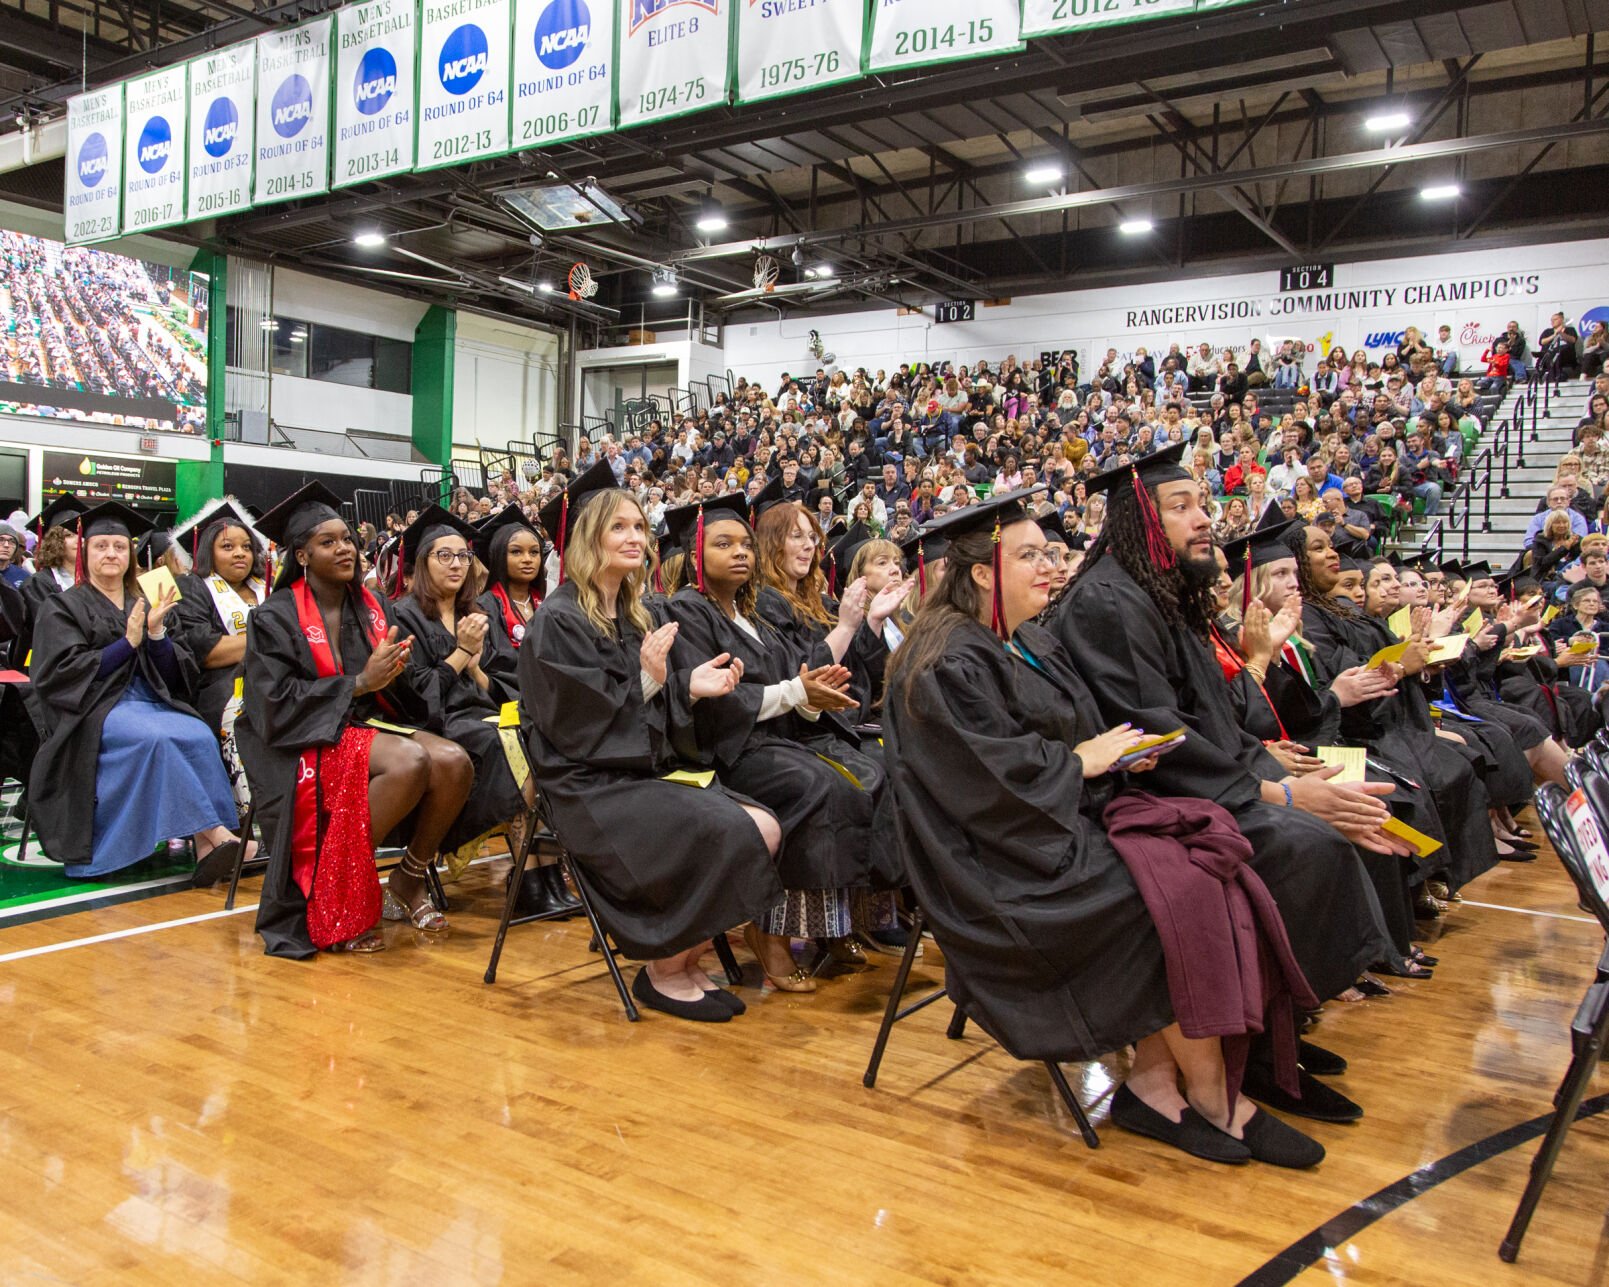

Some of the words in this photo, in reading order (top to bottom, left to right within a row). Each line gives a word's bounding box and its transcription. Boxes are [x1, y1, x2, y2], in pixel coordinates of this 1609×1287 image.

[357, 0, 392, 26] MEN'S
[342, 13, 412, 50] BASKETBALL
[540, 25, 591, 56] NCAA
[648, 21, 685, 48] ELITE
[689, 17, 699, 34] 8
[895, 18, 994, 56] 2014-15
[262, 43, 328, 73] BASKETBALL
[443, 52, 488, 83] NCAA
[760, 51, 840, 89] 1975-76
[144, 75, 169, 94] MEN'S
[195, 70, 251, 97] BASKETBALL
[356, 75, 397, 102] NCAA
[518, 76, 563, 98] ROUND
[568, 70, 585, 87] OF
[588, 63, 607, 81] 64
[83, 95, 107, 113] MEN'S
[129, 89, 183, 114] BASKETBALL
[424, 100, 465, 123] ROUND
[468, 95, 483, 112] OF
[487, 89, 504, 107] 64
[639, 77, 706, 114] 1974-75
[71, 105, 119, 130] BASKETBALL
[274, 101, 312, 126] NCAA
[340, 118, 375, 142] ROUND
[378, 114, 392, 131] OF
[395, 110, 410, 126] 64
[522, 105, 600, 140] 2006-07
[204, 121, 237, 146] NCAA
[433, 130, 492, 160] 2012-13
[141, 141, 171, 162] NCAA
[260, 144, 293, 161] ROUND
[295, 139, 308, 153] OF
[311, 135, 324, 149] 64
[80, 157, 108, 176] NCAA
[193, 163, 222, 179] ROUND
[224, 157, 235, 171] OF
[235, 153, 249, 167] 32
[348, 148, 399, 177] 2013-14
[129, 177, 156, 193] ROUND
[158, 174, 168, 188] OF
[169, 171, 181, 185] 64
[267, 171, 314, 195] 2014-15
[69, 189, 94, 208] ROUND
[96, 188, 107, 203] OF
[107, 186, 118, 199] 64
[198, 189, 241, 212] 2015-16
[74, 217, 112, 237] 2022-23
[134, 204, 173, 226] 2016-17
[1286, 271, 1328, 290] 104
[940, 306, 970, 322] 102
[1126, 300, 1262, 328] RANGERVISION
[1270, 288, 1397, 316] COMMUNITY
[1404, 275, 1539, 305] CHAMPIONS
[1364, 331, 1405, 349] LYNC
